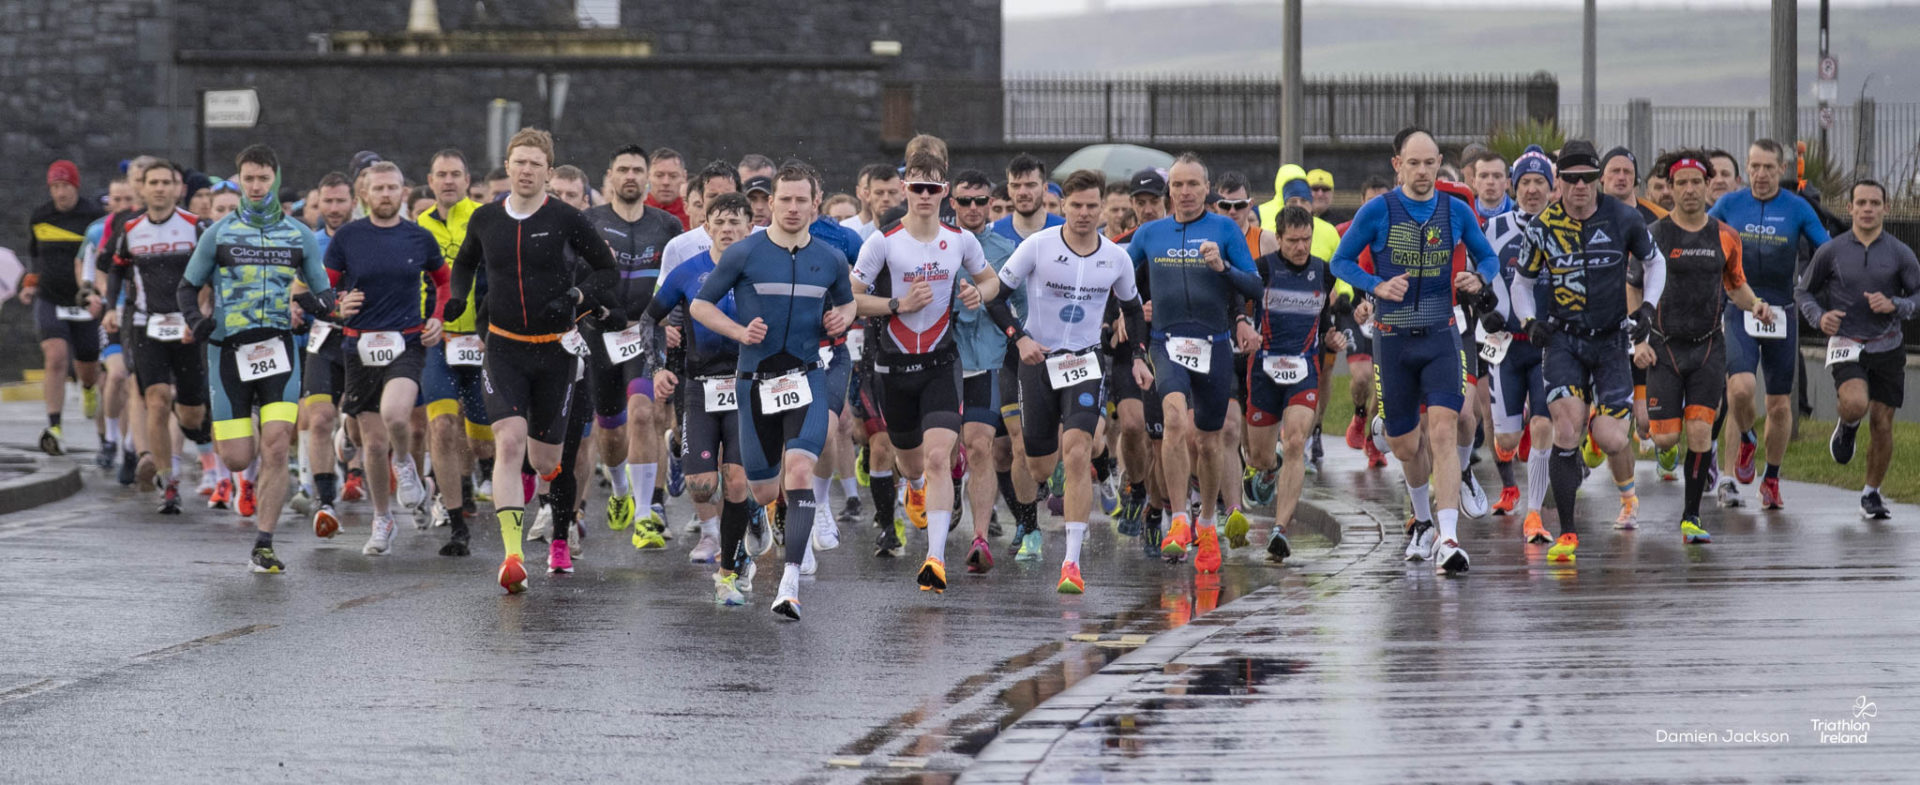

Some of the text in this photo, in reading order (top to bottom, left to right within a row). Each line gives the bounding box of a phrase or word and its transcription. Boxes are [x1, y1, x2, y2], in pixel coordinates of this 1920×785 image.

[230, 247, 292, 258] Clonmel
[1391, 249, 1450, 266] CARLOW
[1682, 248, 1716, 257] INVERSE
[1556, 254, 1610, 268] Naas
[1046, 281, 1076, 291] Athlete
[1063, 292, 1092, 301] Coach
[1755, 321, 1777, 333] 148
[458, 349, 482, 362] 303
[619, 341, 644, 357] 207
[1831, 348, 1850, 359] 158
[369, 349, 393, 363] 100
[250, 358, 277, 375] 284
[1062, 367, 1088, 383] 135
[1274, 370, 1297, 380] 208
[775, 391, 800, 408] 109
